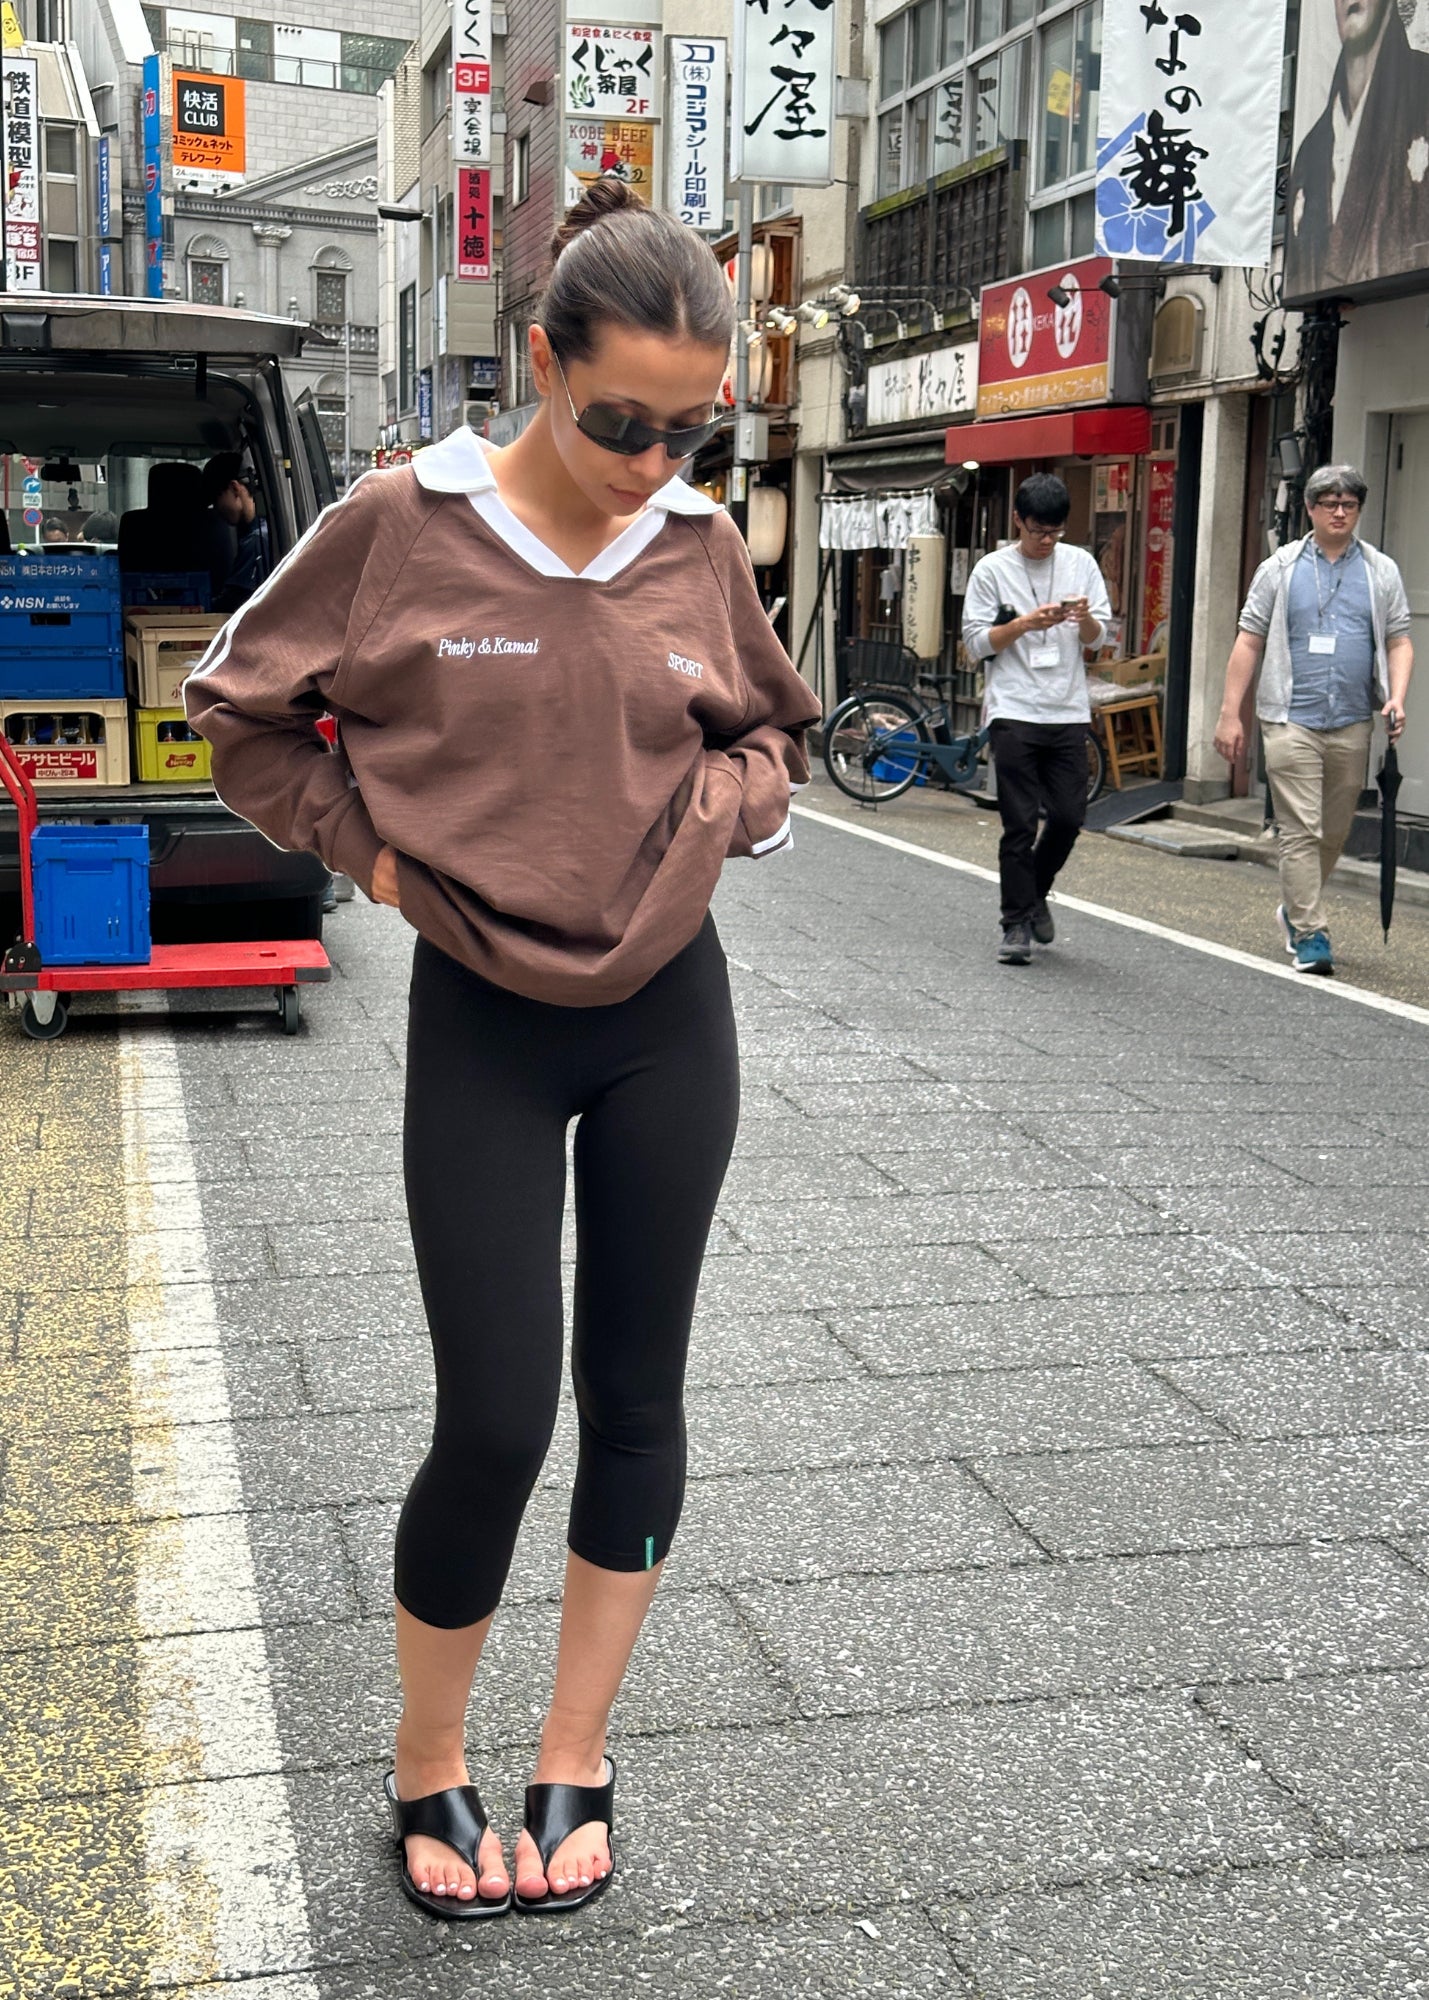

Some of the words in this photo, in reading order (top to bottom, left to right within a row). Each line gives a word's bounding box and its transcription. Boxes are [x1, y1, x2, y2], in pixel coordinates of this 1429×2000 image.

[571, 38, 654, 78] くじゃく
[458, 69, 487, 87] 3F
[597, 74, 638, 97] 茶屋
[183, 89, 218, 111] 快活
[625, 98, 650, 114] 2F
[184, 111, 218, 127] CLUB
[463, 97, 482, 156] 宴会場
[569, 125, 606, 140] KOBE
[611, 128, 648, 144] BEEF
[181, 151, 222, 165] テレワーク
[680, 211, 711, 225] 2F
[463, 206, 485, 259] 十徳
[15, 597, 44, 609] NSN
[437, 638, 475, 658] Pinky
[478, 638, 491, 654] &
[492, 637, 539, 654] Kamal
[667, 652, 704, 679] SPORT
[17, 753, 95, 766] アサヒビール
